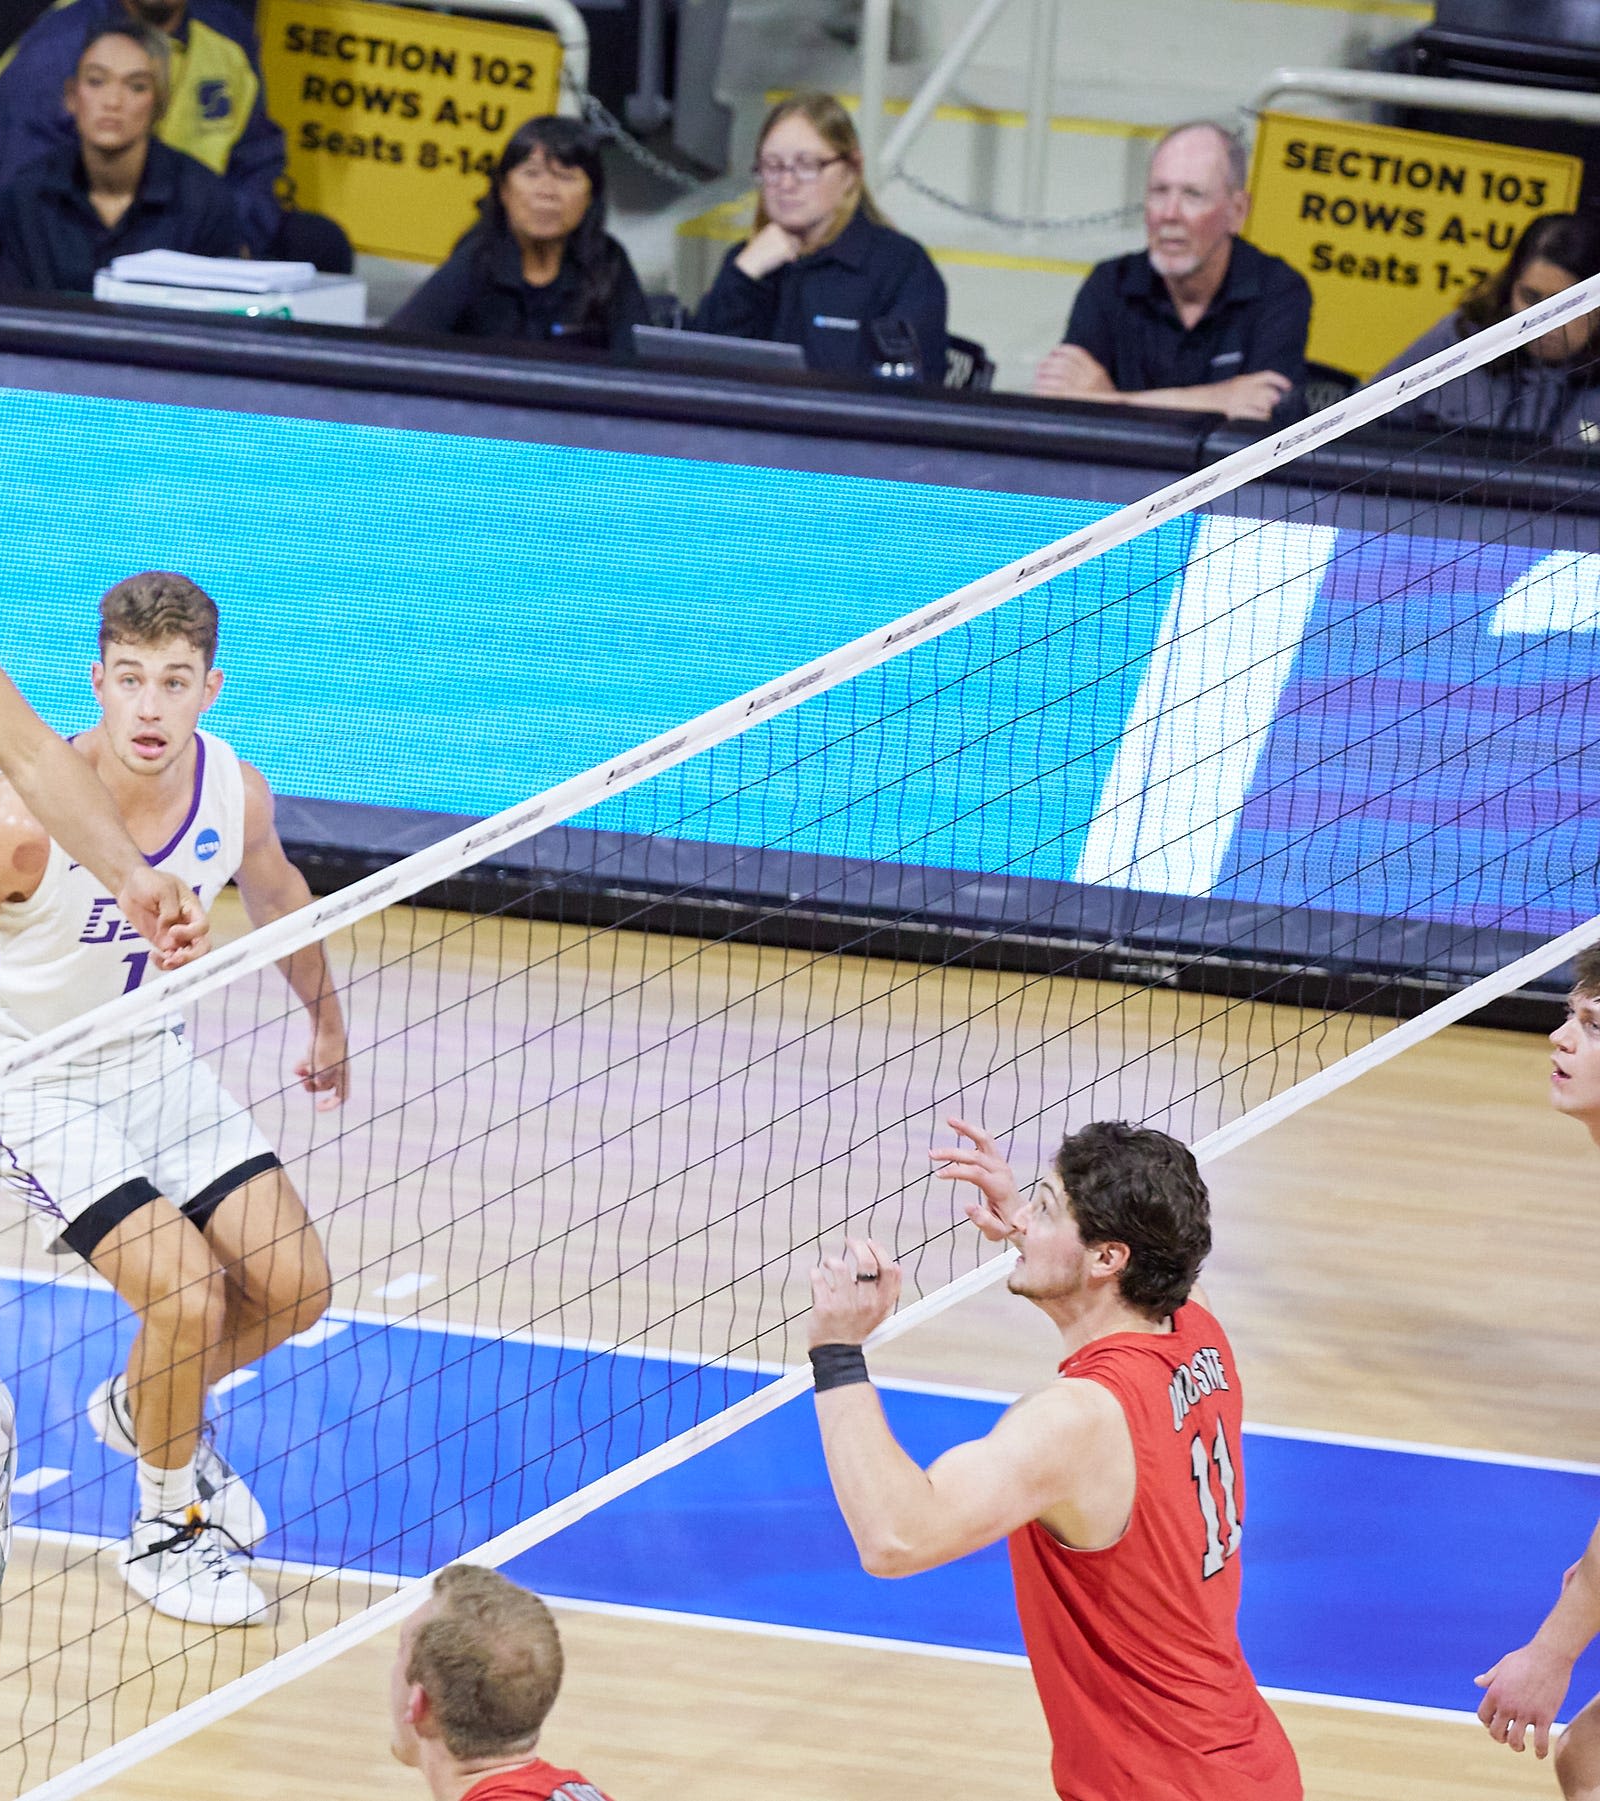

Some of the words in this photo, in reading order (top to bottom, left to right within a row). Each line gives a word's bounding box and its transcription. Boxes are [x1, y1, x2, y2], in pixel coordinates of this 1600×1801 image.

[284, 23, 457, 78] SECTION
[471, 54, 536, 91] 102
[301, 74, 422, 119] ROWS
[435, 98, 507, 133] A-U
[299, 121, 404, 164] Seats
[417, 140, 498, 176] 8-14
[1285, 140, 1466, 195] SECTION
[1481, 172, 1548, 207] 103
[1301, 193, 1426, 237] ROWS
[1439, 217, 1516, 251] A-U
[1311, 243, 1419, 285] Seats
[1191, 1412, 1243, 1581] 11
